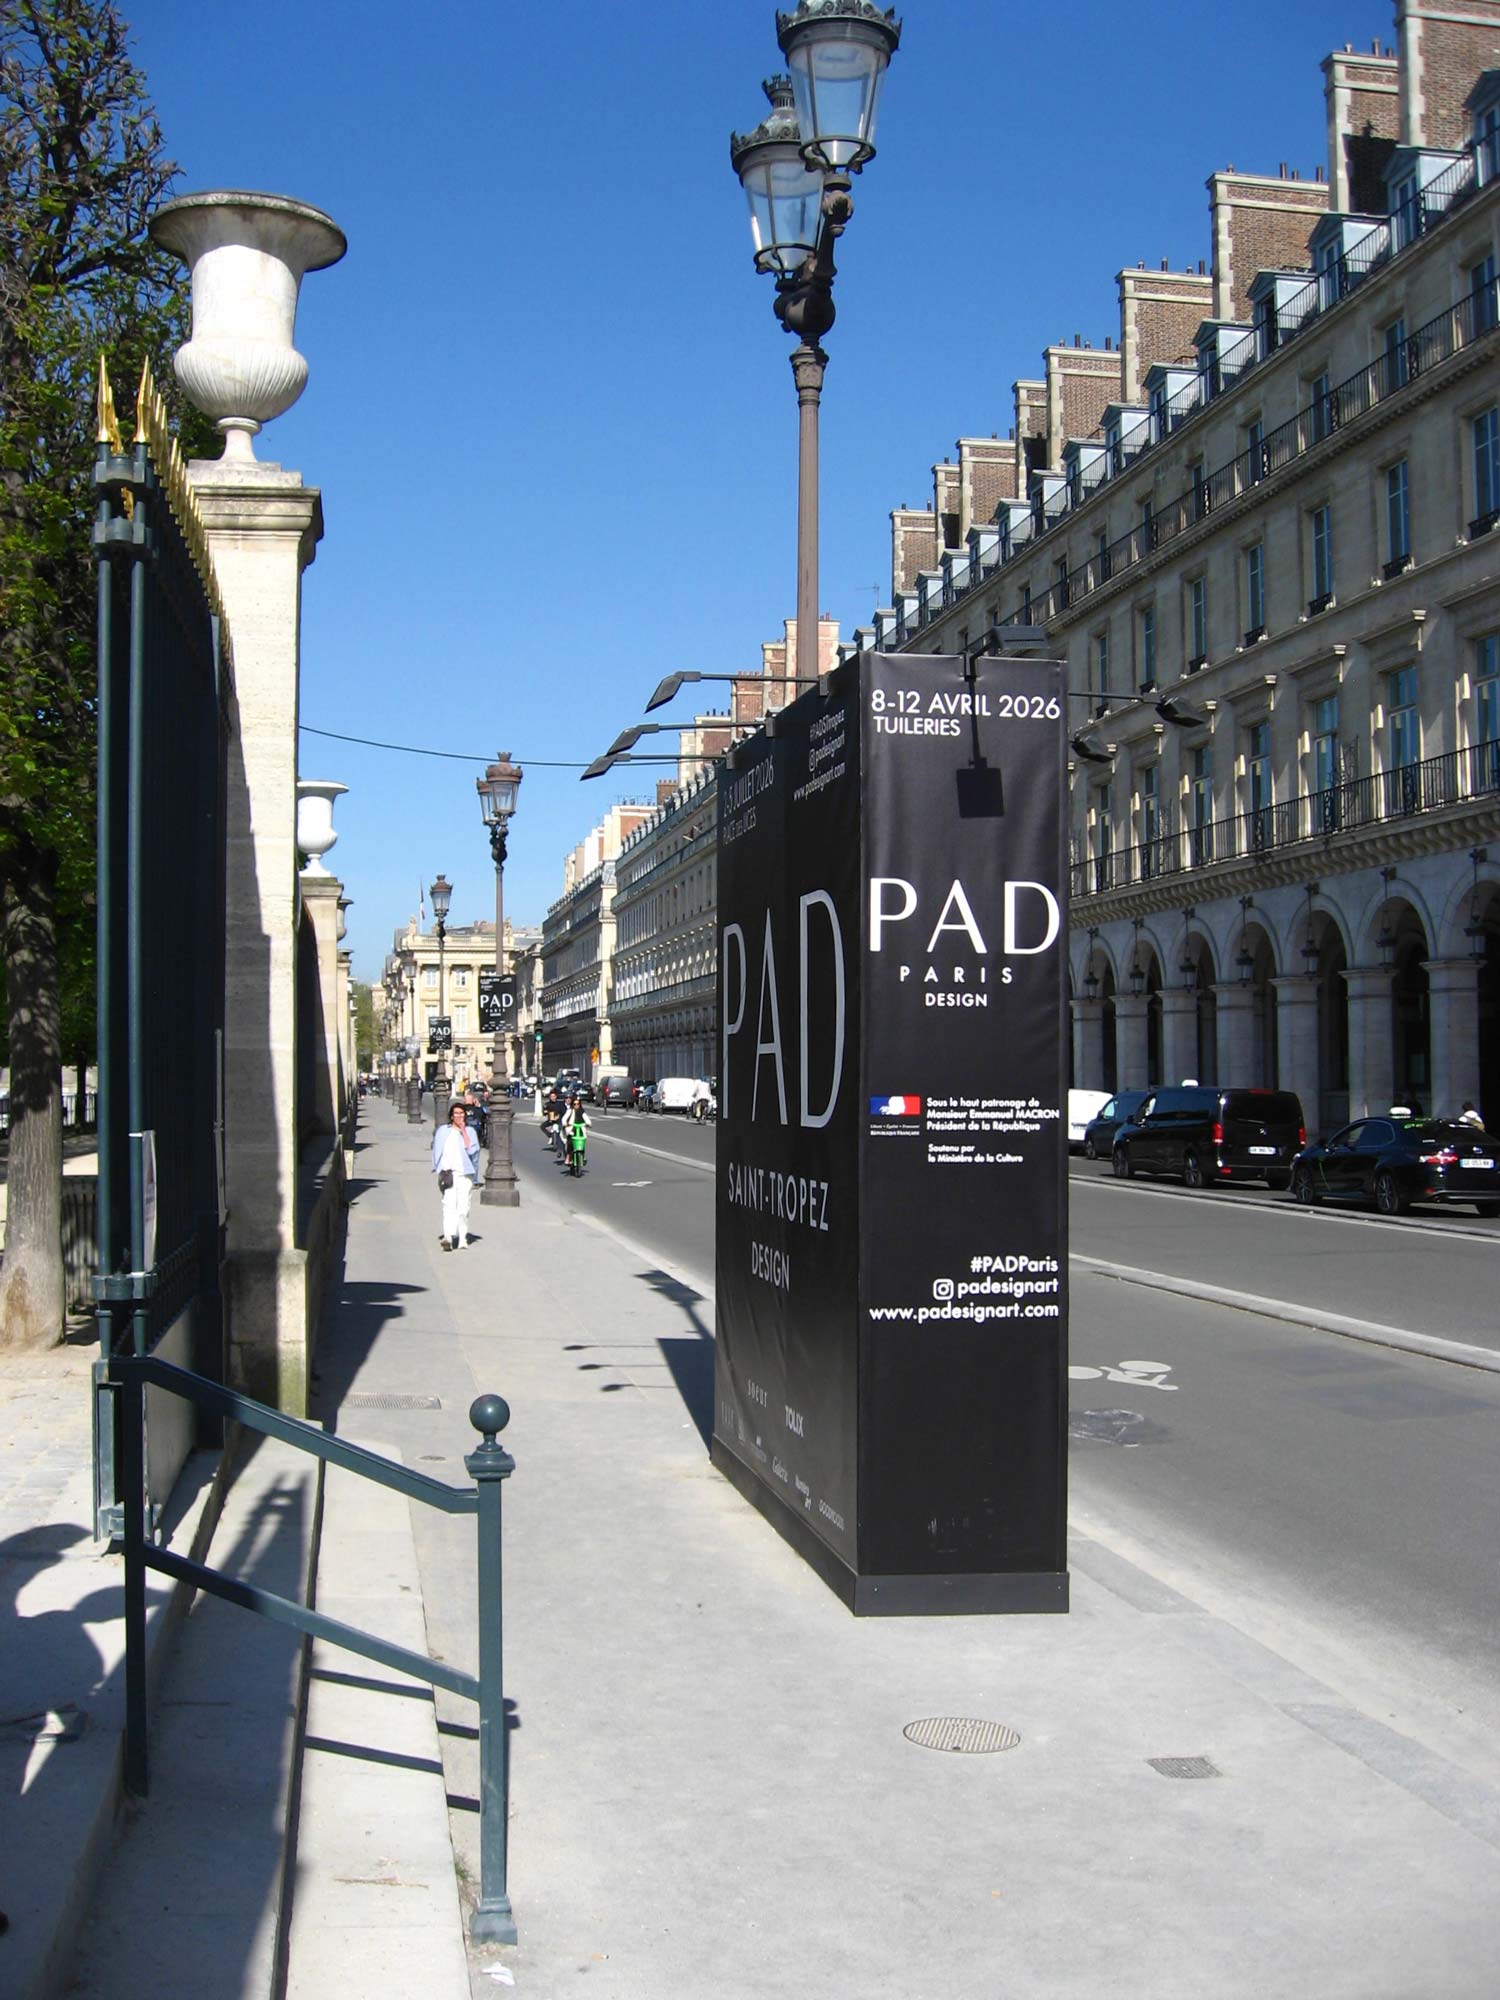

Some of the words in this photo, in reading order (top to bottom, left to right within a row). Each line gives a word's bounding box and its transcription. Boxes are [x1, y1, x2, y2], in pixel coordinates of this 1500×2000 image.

[871, 689, 920, 713] 8-12
[928, 692, 991, 716] AVRIL
[999, 694, 1060, 719] 2026
[873, 716, 961, 737] TUILERIES
[734, 768, 756, 811] JUILLET
[755, 755, 774, 795] 2026
[869, 876, 1061, 955] PAD
[899, 965, 1013, 984] PARIS
[480, 993, 513, 1009] PAD
[722, 888, 846, 1130] PAD
[925, 993, 988, 1008] DESIGN
[430, 1027, 451, 1036] PAD
[927, 1097, 948, 1108] Sous
[949, 1097, 958, 1108] le
[960, 1097, 980, 1108] haut
[981, 1099, 1026, 1110] patronage
[1028, 1097, 1040, 1108] de
[927, 1109, 968, 1119] Monsieur
[969, 1109, 1013, 1119] Emmanuel
[1016, 1109, 1060, 1119] MACRON
[927, 1121, 966, 1131] Président
[968, 1121, 980, 1131] de
[982, 1121, 991, 1131] la
[993, 1121, 1041, 1133] République
[928, 1144, 960, 1153] Soutenu
[961, 1146, 976, 1155] par
[928, 1154, 936, 1163] le
[937, 1154, 973, 1163] Ministère
[974, 1154, 985, 1163] de
[986, 1154, 995, 1163] la
[996, 1154, 1024, 1163] Culture
[728, 1162, 830, 1231] SAINT-TROPEZ
[751, 1241, 790, 1291] DESIGN
[969, 1254, 1059, 1273] #PADParis
[957, 1276, 1059, 1301] padesignart
[868, 1301, 1060, 1324] www.padesignart.com
[784, 1404, 804, 1438] TOLIX
